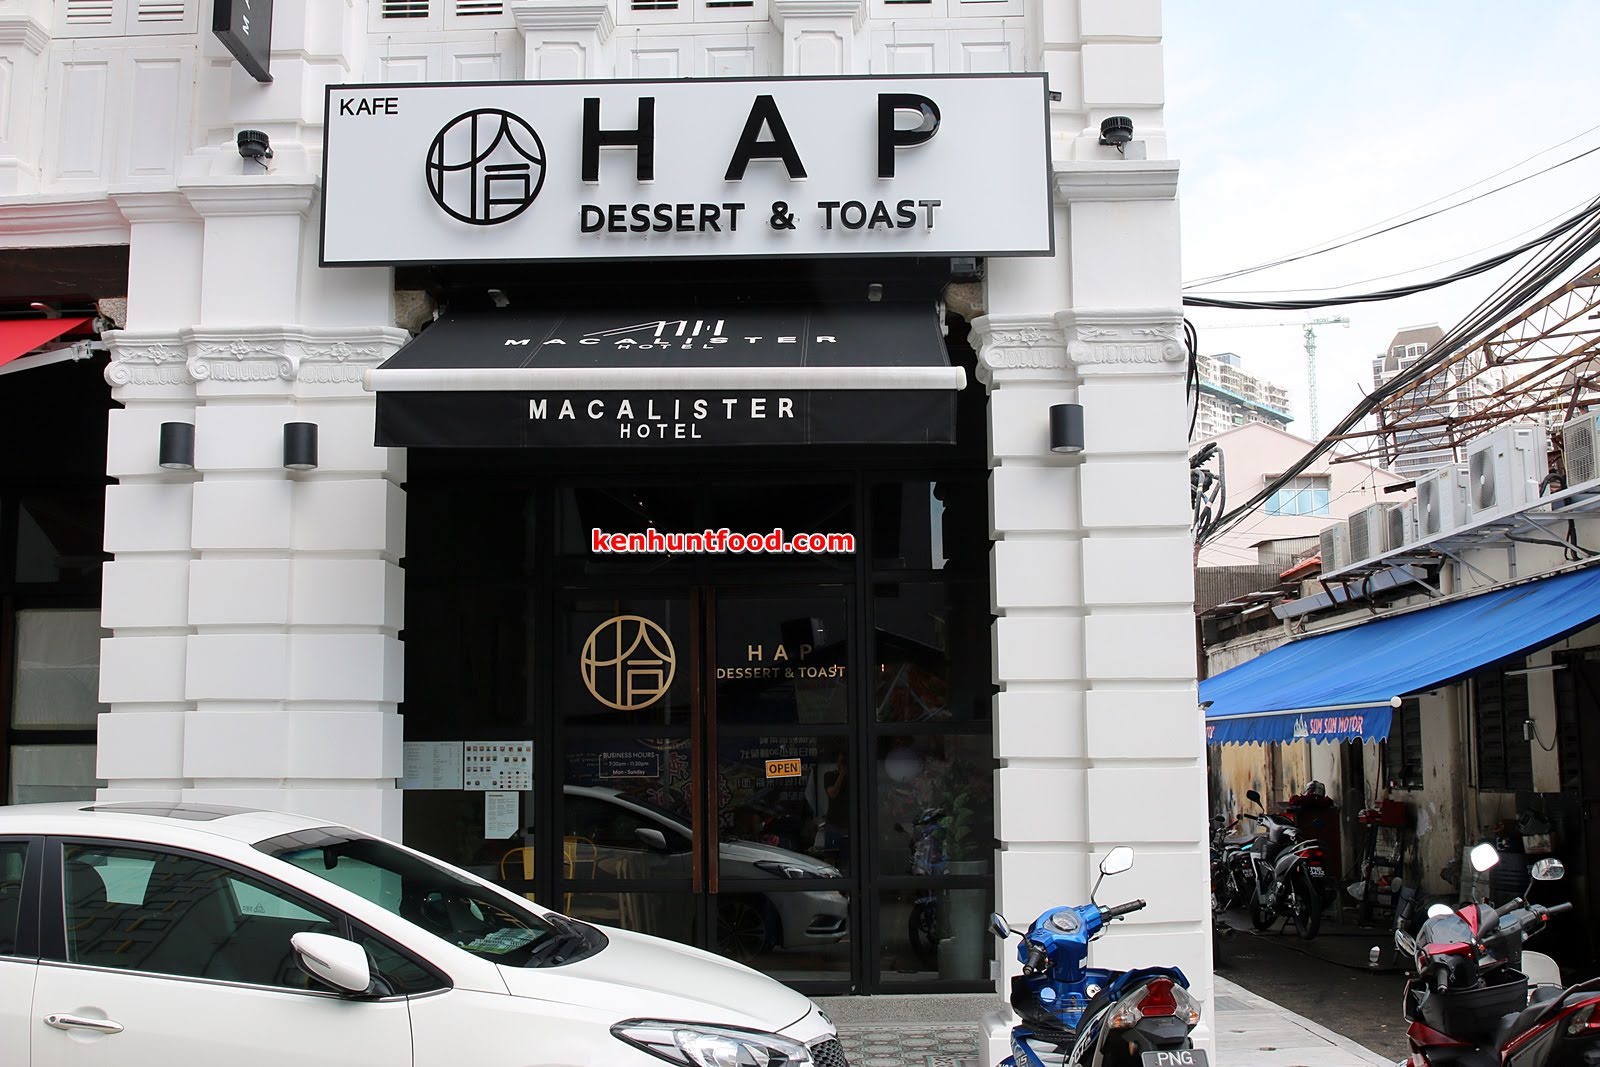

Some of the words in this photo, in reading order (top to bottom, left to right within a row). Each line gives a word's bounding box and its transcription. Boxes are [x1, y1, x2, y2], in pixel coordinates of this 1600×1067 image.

[340, 98, 398, 115] KAFE
[582, 94, 940, 182] HAP
[581, 204, 746, 233] DESSERT
[770, 203, 796, 230] &
[818, 200, 942, 230] TOAST
[504, 335, 838, 346] MACALISTER
[529, 398, 794, 420] MACALISTER
[620, 423, 702, 439] HOTEL
[747, 644, 812, 661] HAP
[716, 667, 780, 679] DESSERT
[784, 668, 794, 678] &
[799, 666, 846, 678] TOAST
[1338, 715, 1364, 734] MOTOR
[769, 763, 797, 774] OPEN
[1157, 1051, 1194, 1066] PNG
